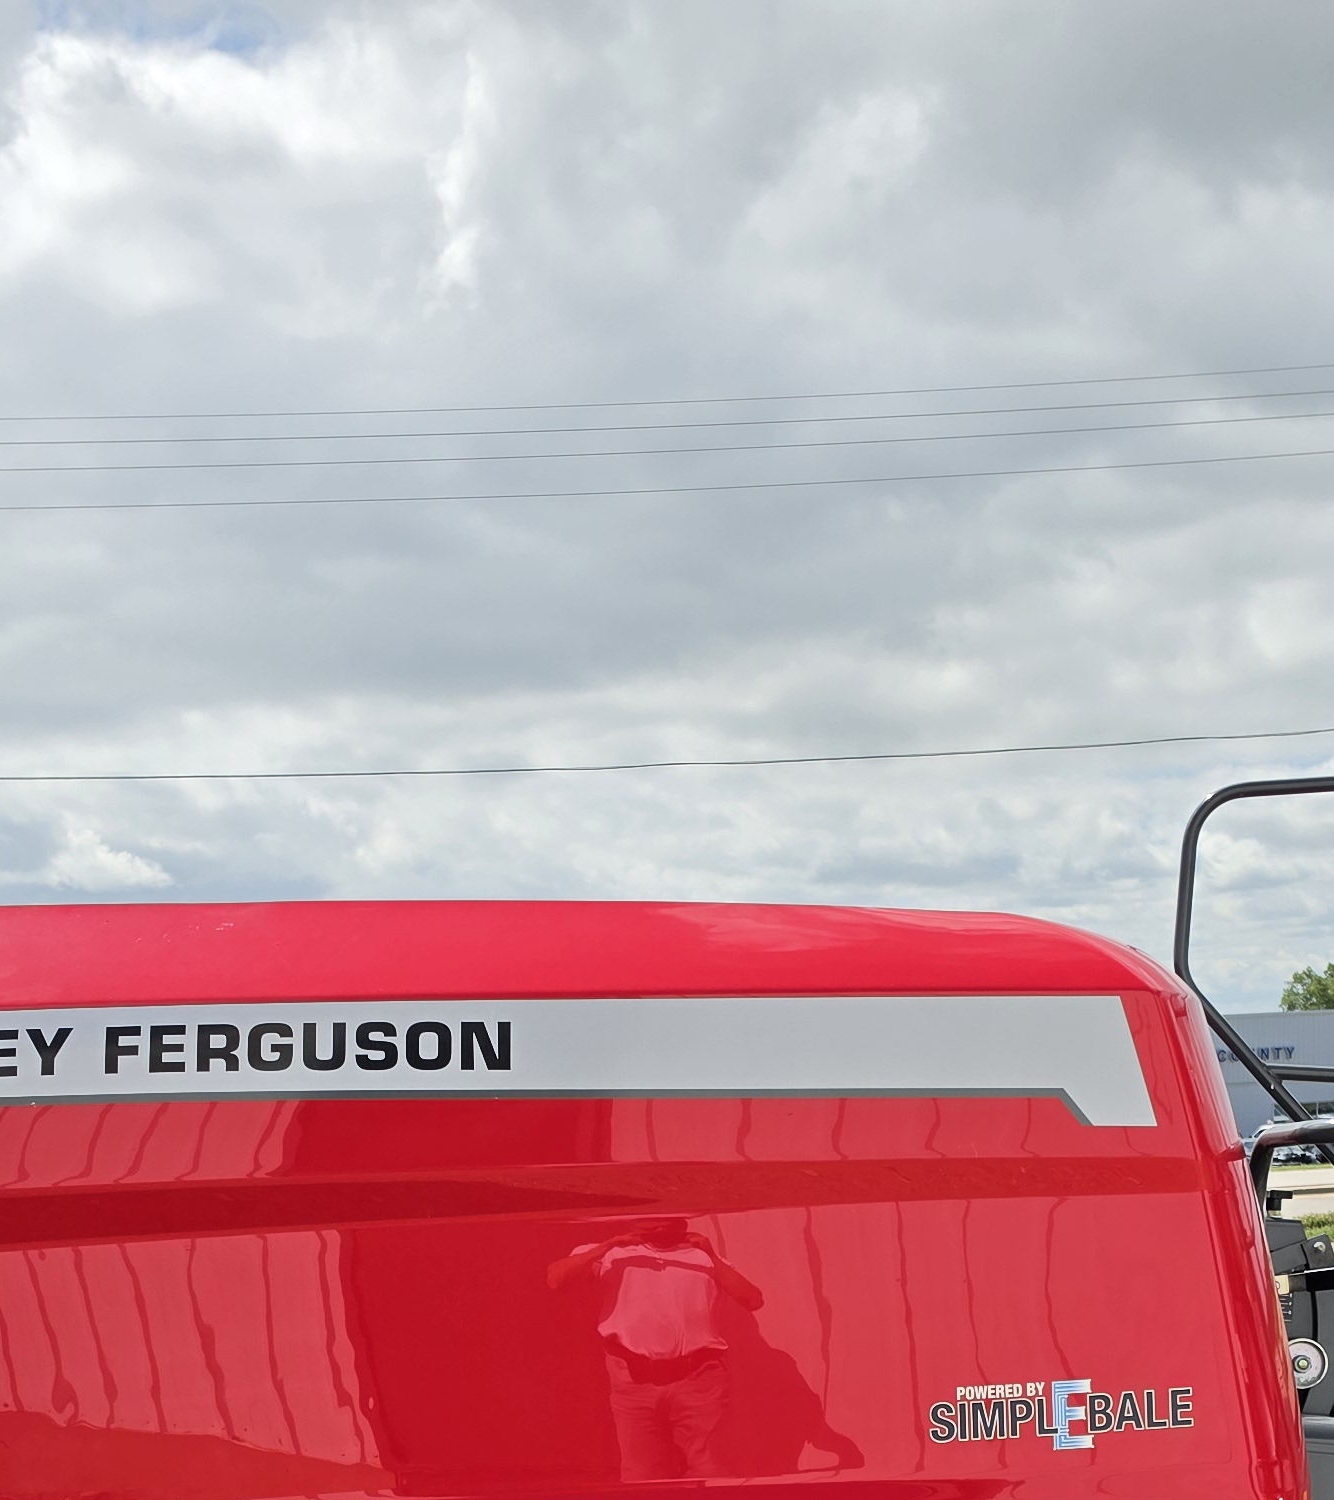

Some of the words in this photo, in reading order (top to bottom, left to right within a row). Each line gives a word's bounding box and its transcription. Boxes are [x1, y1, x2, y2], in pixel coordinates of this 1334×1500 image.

[104, 1020, 513, 1075] FERGUSON
[956, 1384, 1023, 1400] POWERED
[1026, 1381, 1046, 1397] BY
